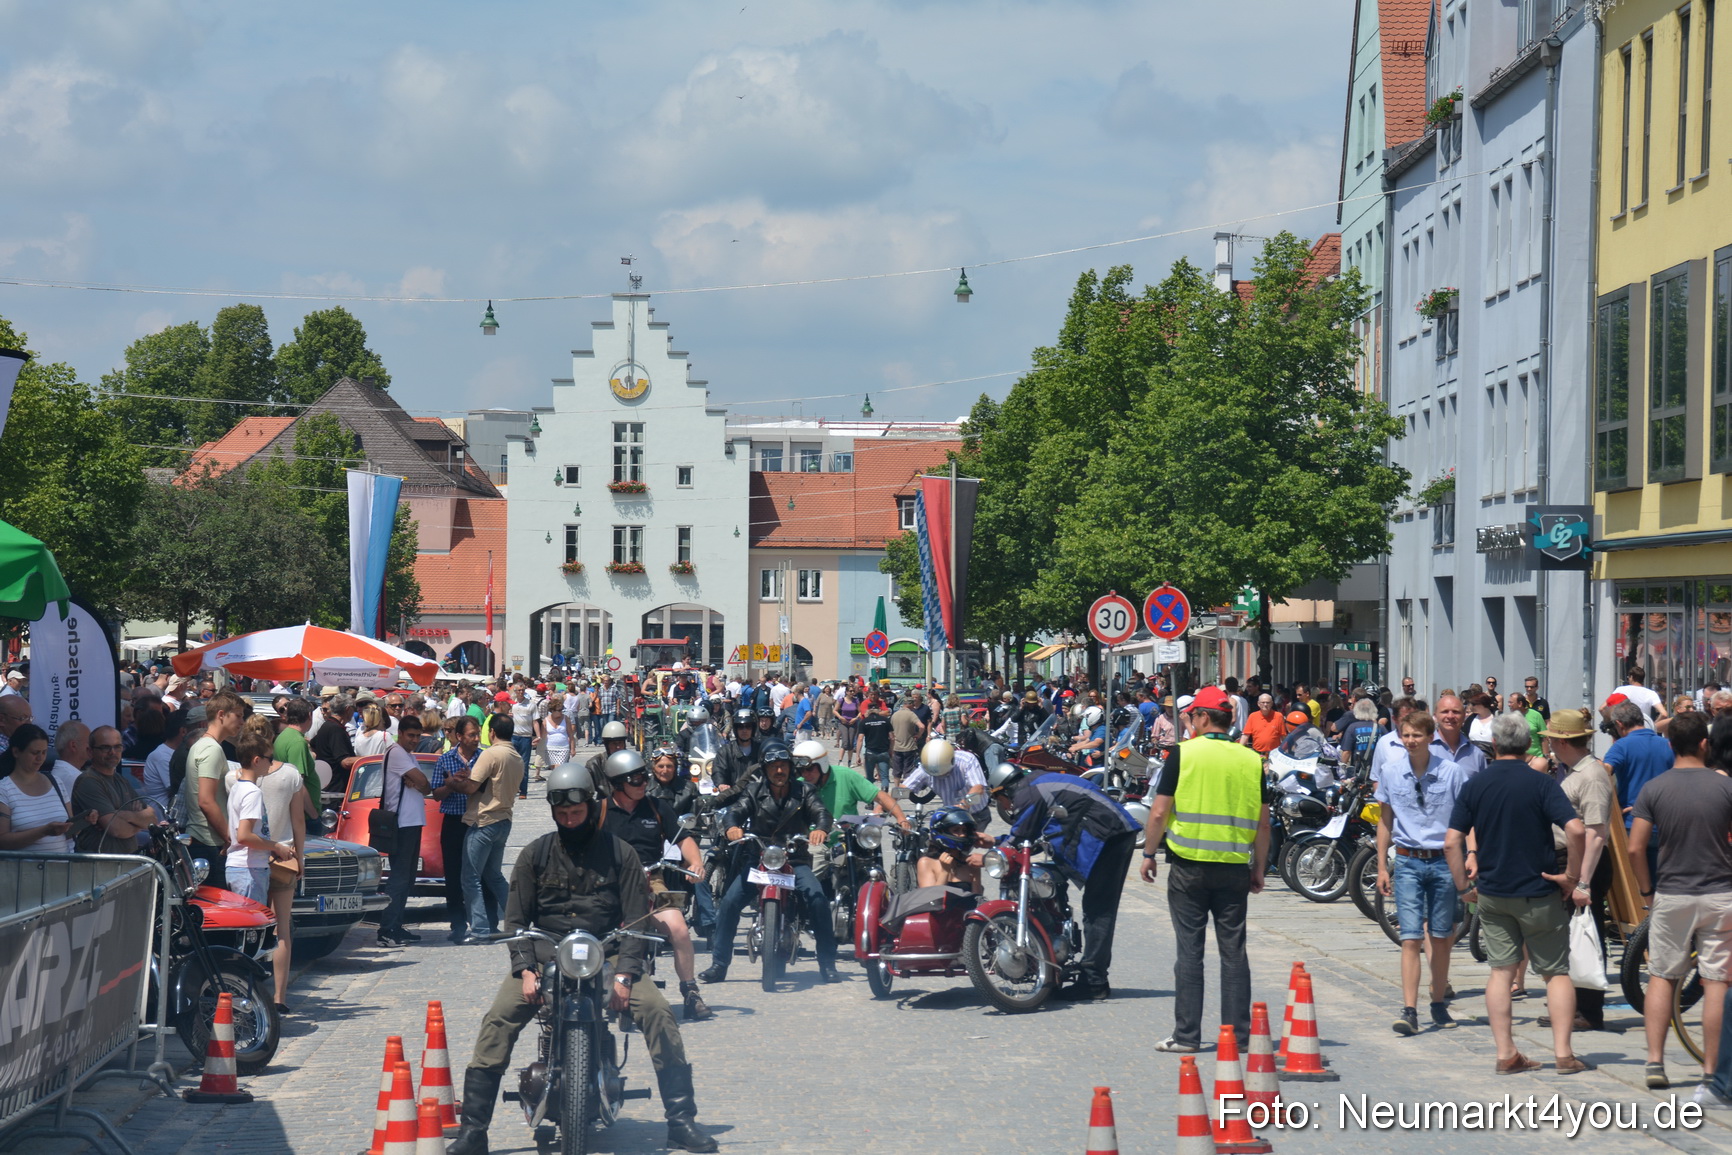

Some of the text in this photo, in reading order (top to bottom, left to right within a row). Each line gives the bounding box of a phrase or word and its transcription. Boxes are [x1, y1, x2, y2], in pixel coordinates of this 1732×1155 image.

[1550, 522, 1573, 549] G2
[1098, 608, 1127, 631] 30
[408, 628, 450, 638] kasse
[324, 897, 334, 910] NM
[0, 900, 115, 1046] ARZT
